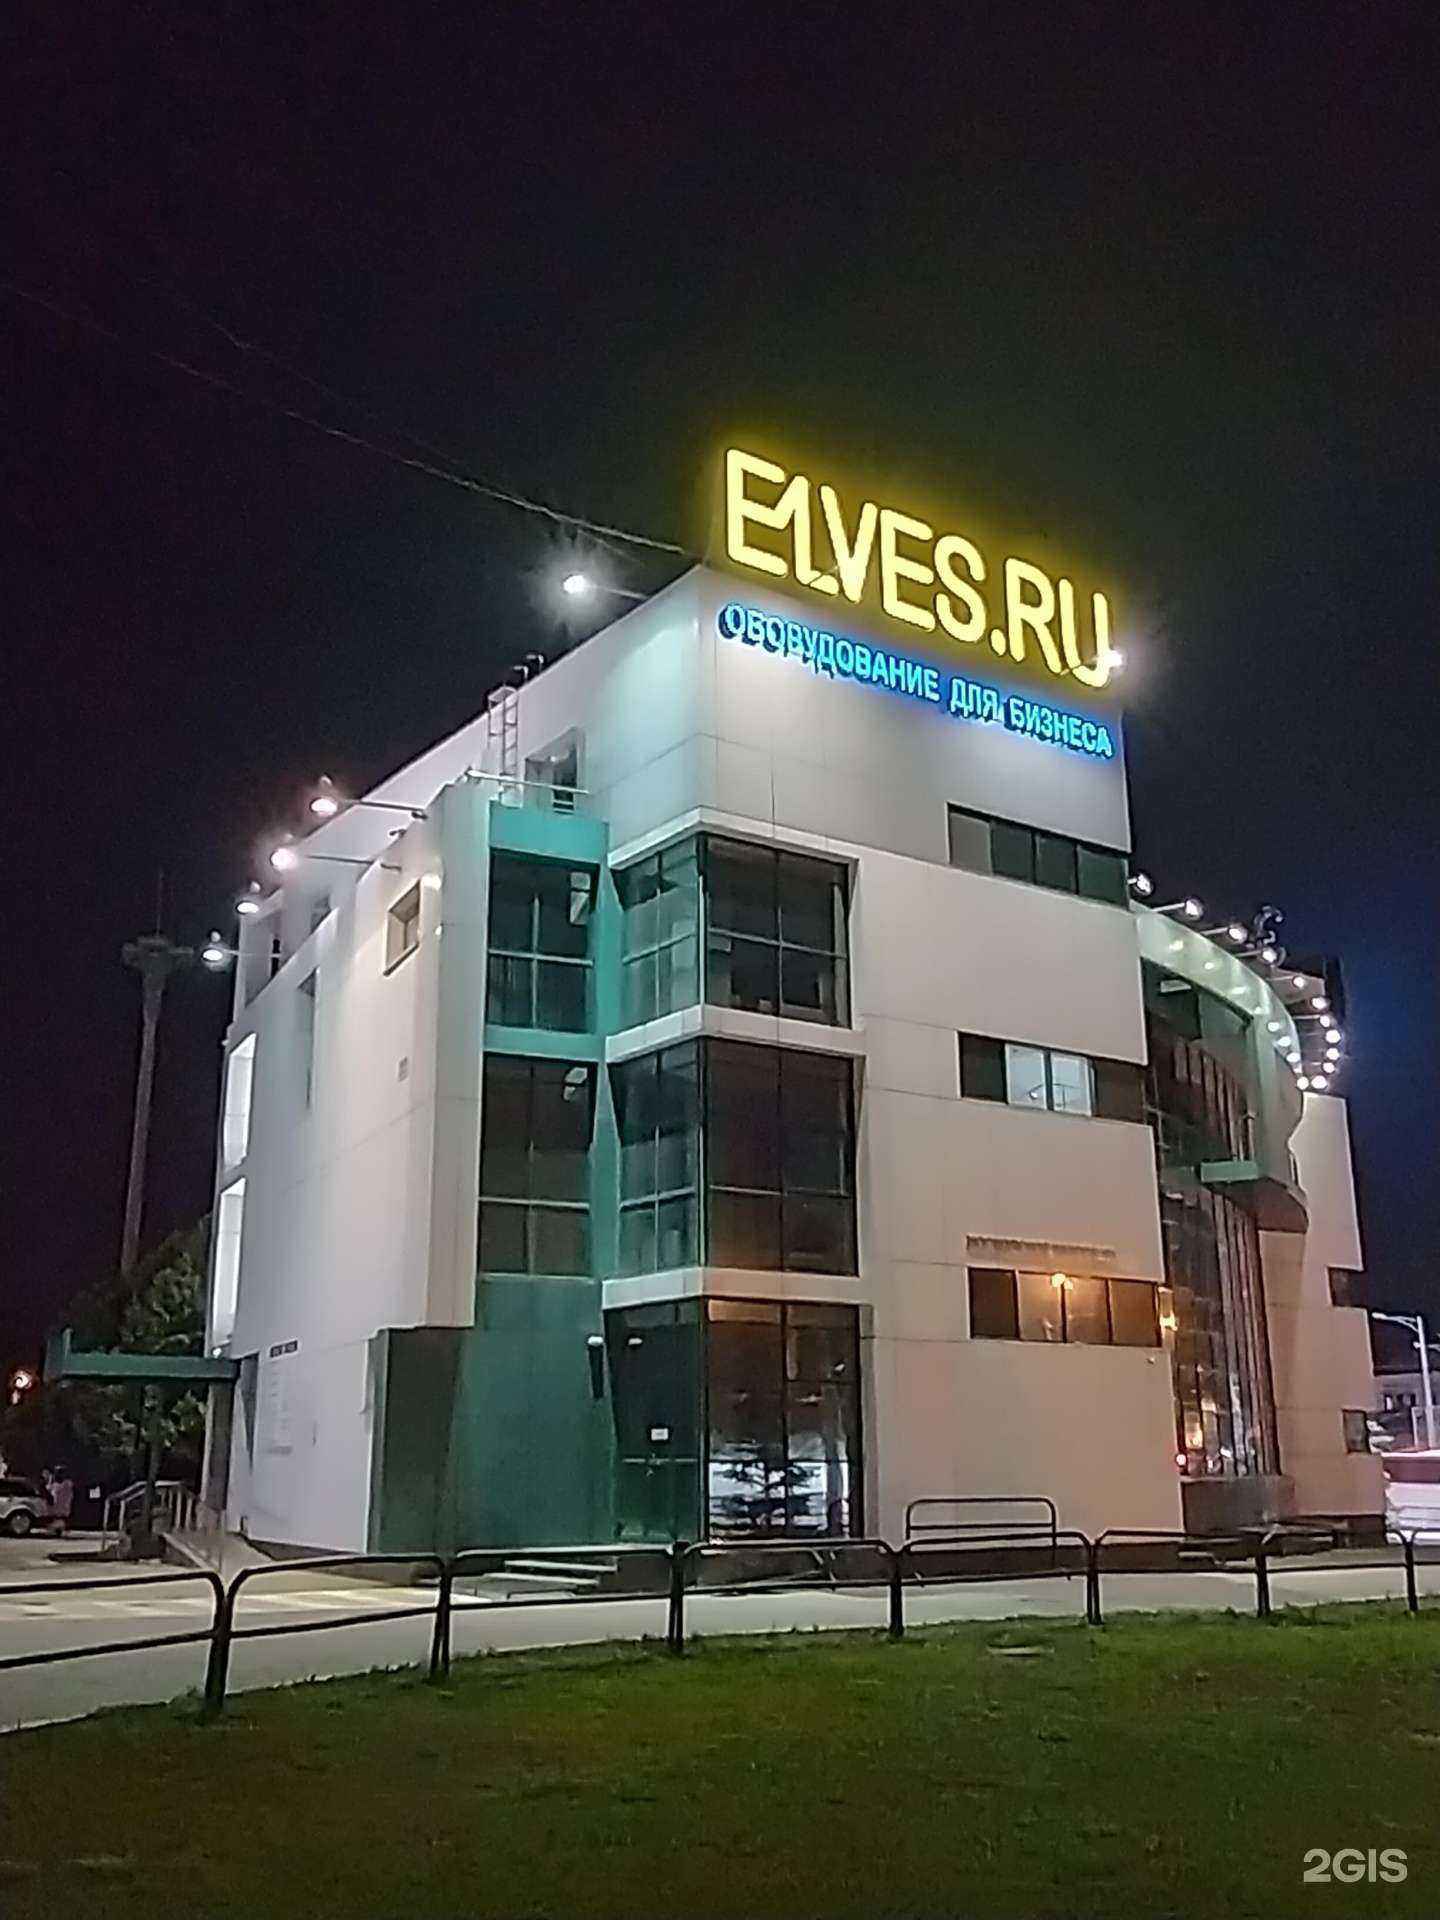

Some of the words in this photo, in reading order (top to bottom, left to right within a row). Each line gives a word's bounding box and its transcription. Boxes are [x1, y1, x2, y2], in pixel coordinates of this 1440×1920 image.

[726, 449, 1111, 688] ELVES.RU
[720, 604, 941, 701] ОБОРУДОВАНИЕ
[949, 676, 1000, 719] ДЛЯ
[1006, 697, 1113, 757] БИЗНЕСА
